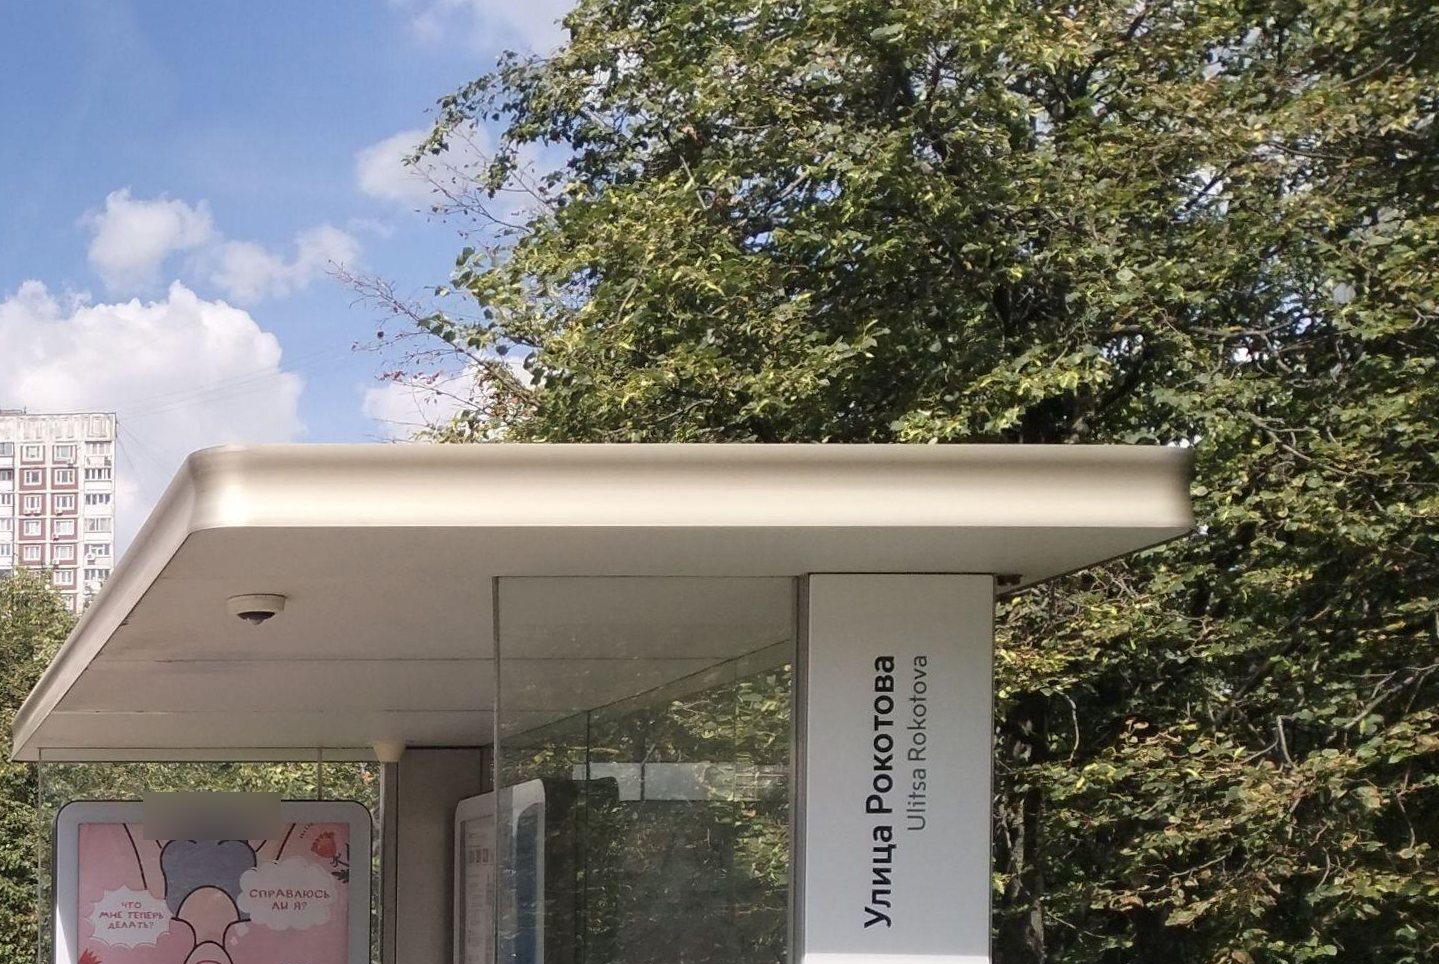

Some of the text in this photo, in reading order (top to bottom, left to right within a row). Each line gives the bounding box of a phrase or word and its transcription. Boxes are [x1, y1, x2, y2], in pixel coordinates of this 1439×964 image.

[907, 655, 928, 831] Ulitsa Rokotova
[864, 655, 897, 928] Улица Рокотова
[249, 888, 330, 899] СПРАВЛЮСЬ
[121, 901, 142, 909] ЧТО
[271, 901, 308, 911] ЛИ Я?
[99, 911, 164, 920] МНЕ ТЕПЕРЬ
[107, 921, 155, 930] ДЕЛАТЬ?
